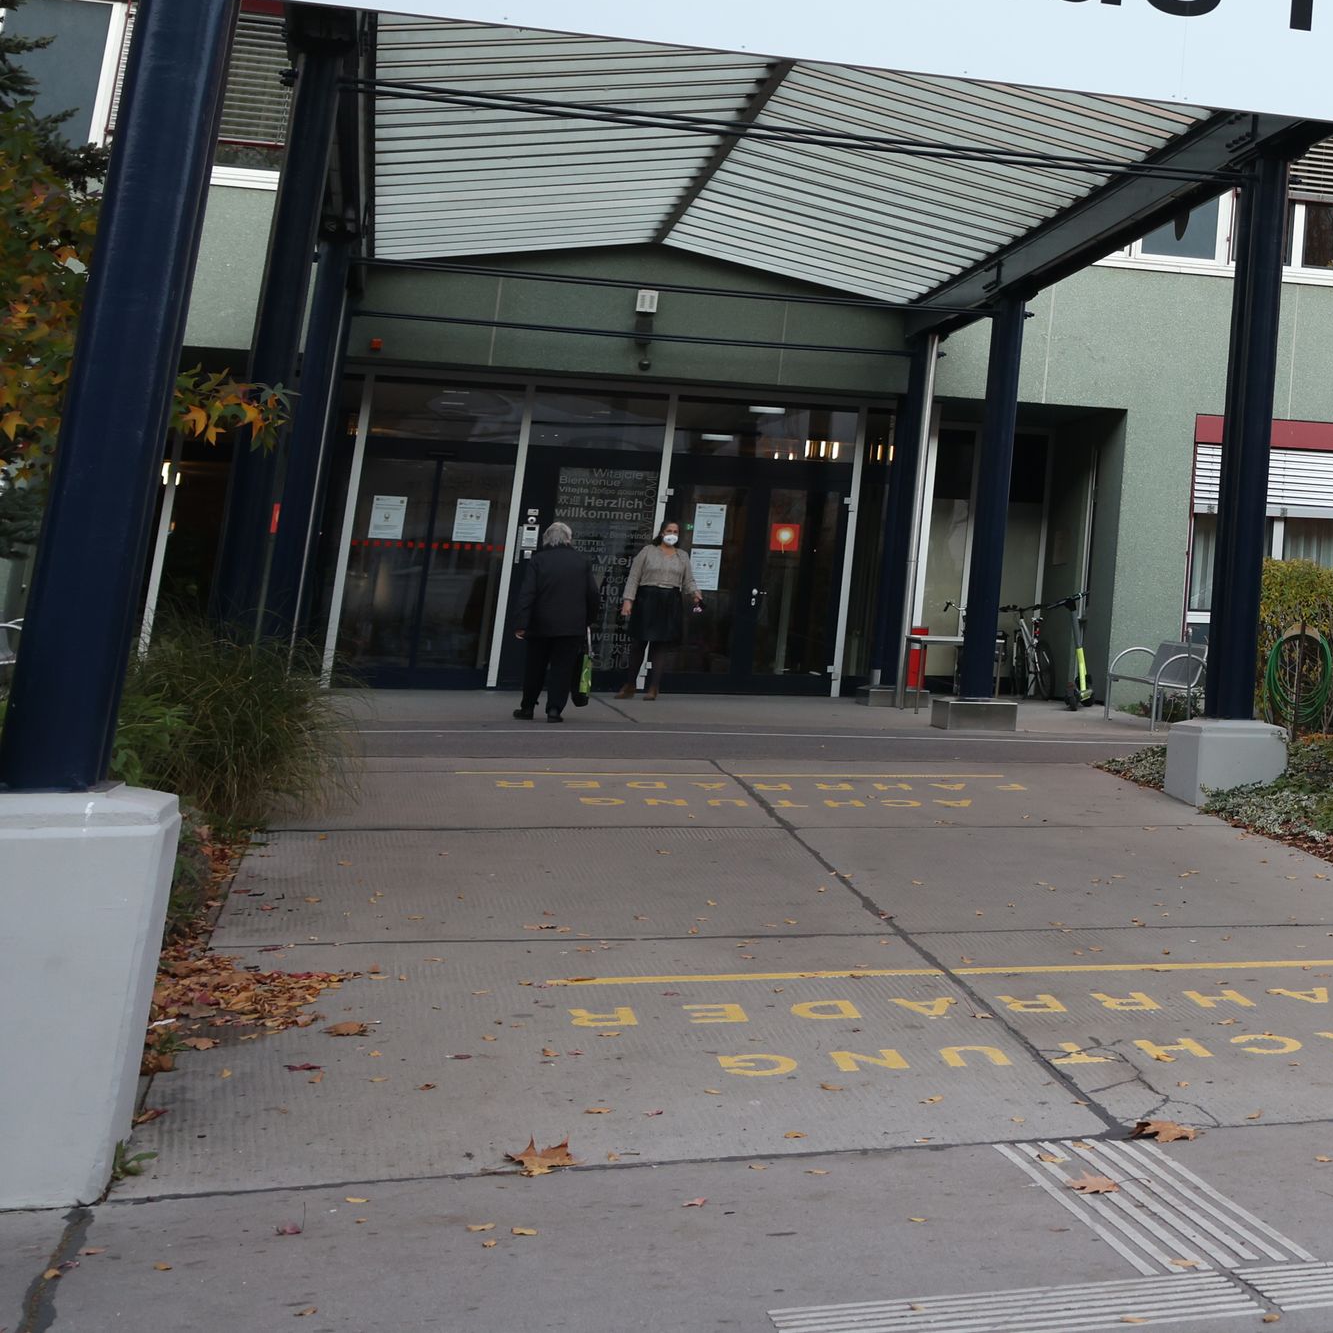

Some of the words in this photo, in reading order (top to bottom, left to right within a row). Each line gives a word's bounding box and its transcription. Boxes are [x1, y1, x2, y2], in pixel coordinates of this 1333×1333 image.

[559, 475, 621, 487] Bienvenue
[584, 496, 643, 509] Herzlich
[555, 507, 642, 521] willkommen
[495, 779, 1028, 792] FAHRRÄDER
[578, 797, 974, 808] ACHTUNG
